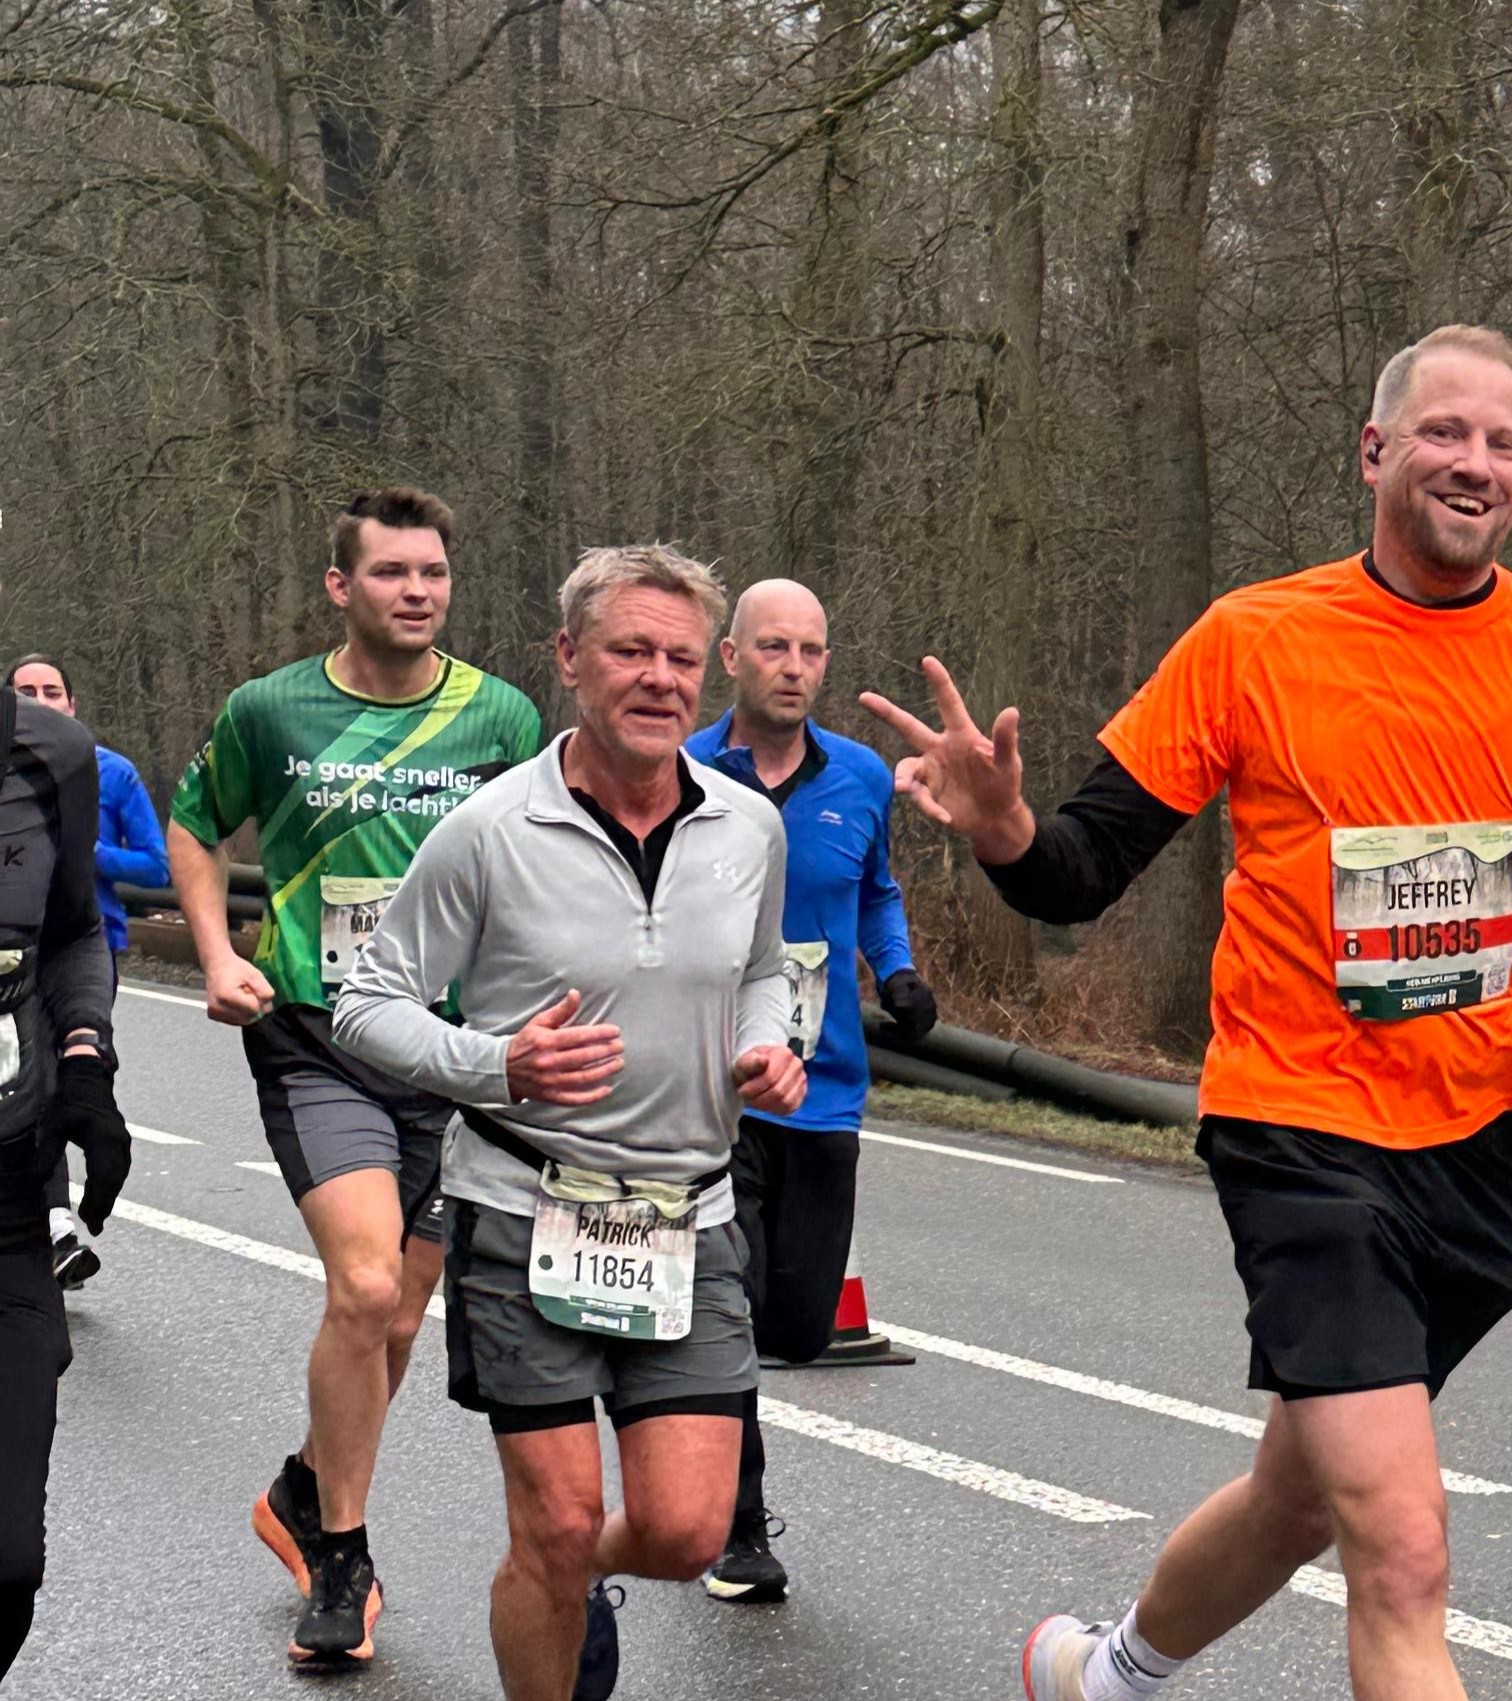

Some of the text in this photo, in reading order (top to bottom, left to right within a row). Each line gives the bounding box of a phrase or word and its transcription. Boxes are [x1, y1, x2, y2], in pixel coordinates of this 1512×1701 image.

[284, 755, 311, 777] Je
[318, 760, 386, 785] gaat
[306, 785, 344, 809] als
[351, 794, 376, 814] je
[1387, 879, 1475, 910] JEFFREY
[1387, 917, 1481, 962] 10535
[576, 1216, 654, 1248] PATRICK
[573, 1250, 655, 1292] 11854
